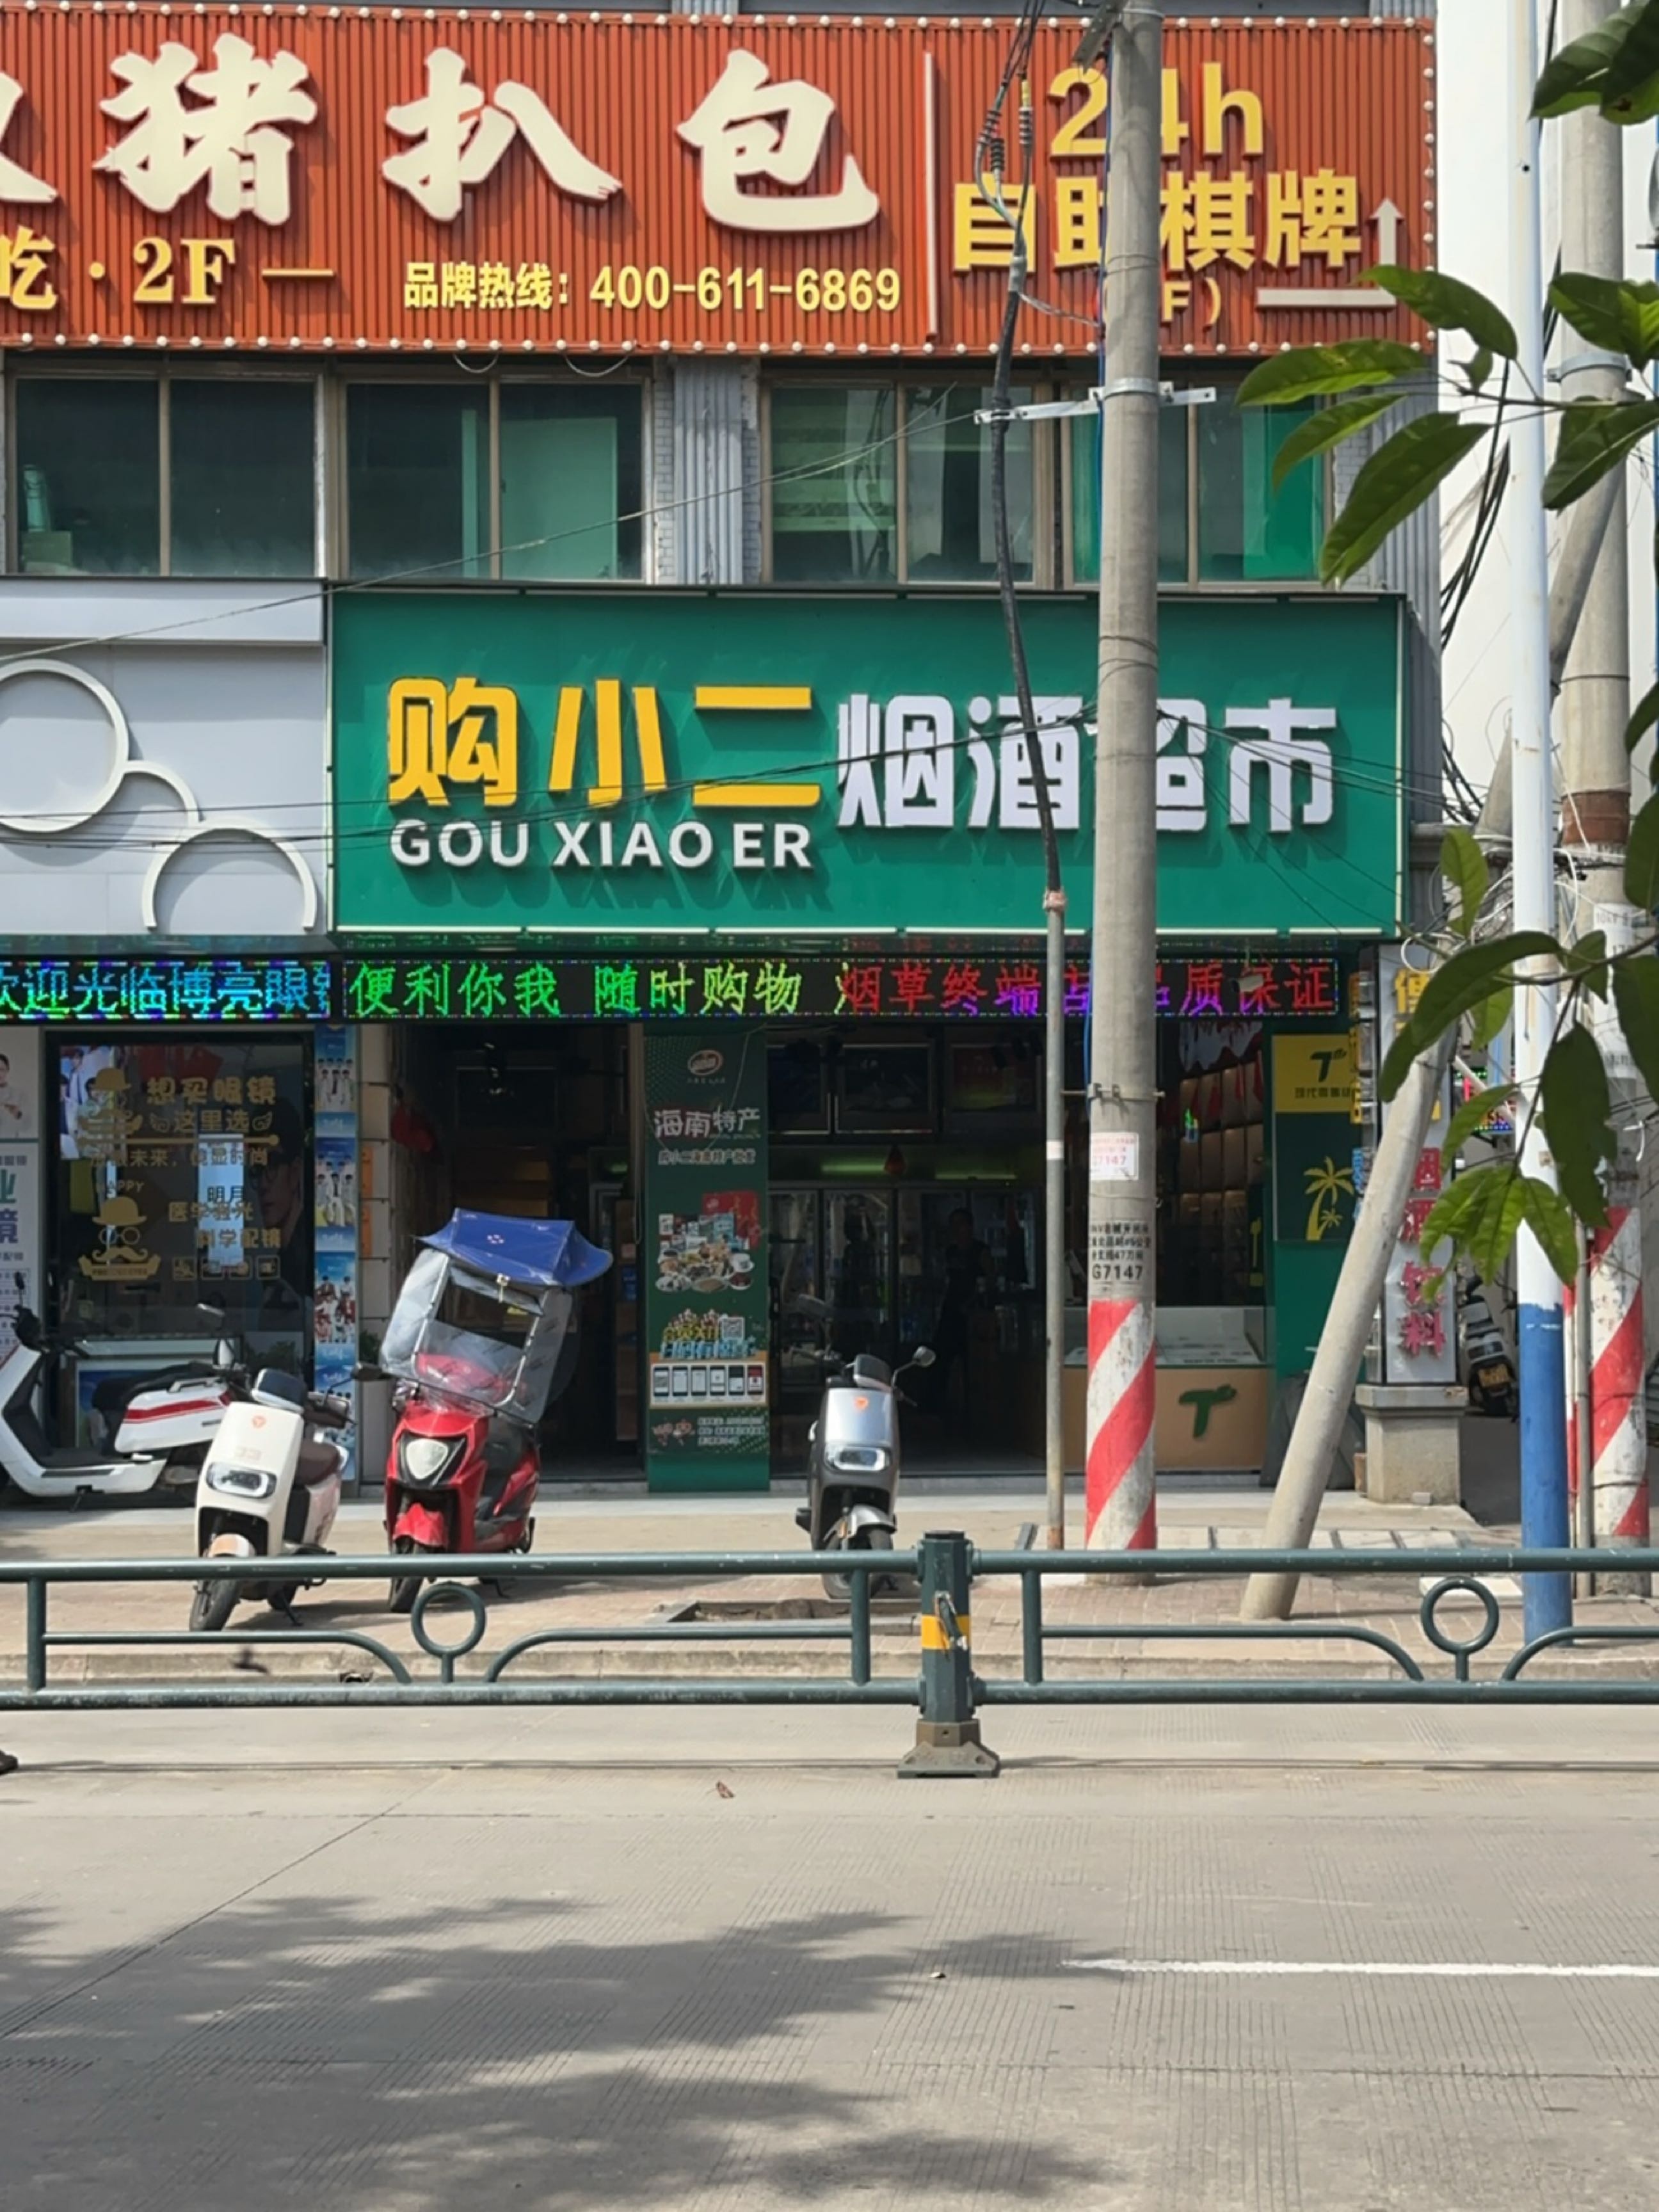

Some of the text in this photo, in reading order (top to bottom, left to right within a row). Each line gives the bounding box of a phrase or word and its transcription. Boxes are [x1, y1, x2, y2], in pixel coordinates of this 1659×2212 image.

[0, 32, 879, 232] 猪扒包
[954, 168, 1361, 273] 自助棋牌
[388, 676, 1338, 833] 购小二 烟酒超市
[390, 818, 813, 869] GOU XIAO ER
[349, 962, 561, 1016] 便利你我
[594, 962, 804, 1016] 随时购物
[147, 1077, 276, 1104] 想买眼镜
[173, 1110, 250, 1133] 这里选
[653, 1106, 761, 1138] 海南特产
[1092, 1263, 1143, 1281] G7147
